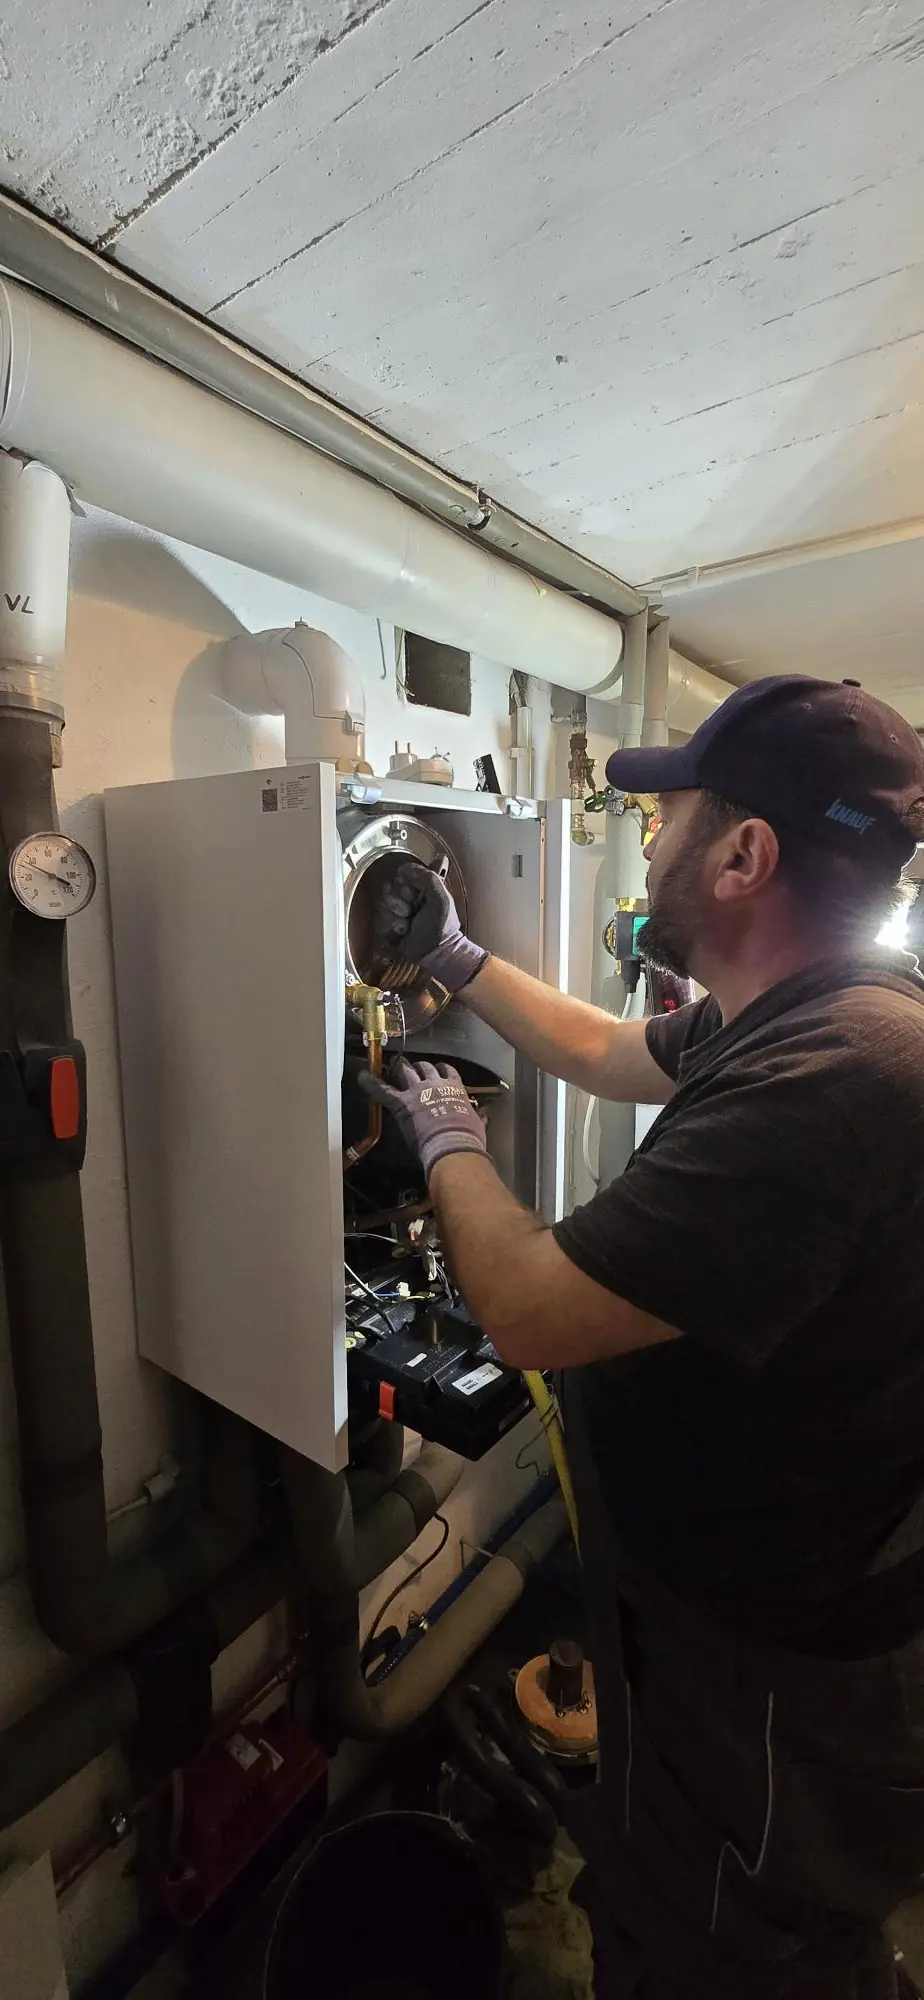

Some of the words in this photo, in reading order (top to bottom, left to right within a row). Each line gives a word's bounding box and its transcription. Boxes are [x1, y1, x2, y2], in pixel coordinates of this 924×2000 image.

[4, 593, 34, 614] VL
[825, 798, 876, 835] KNAUF
[44, 849, 52, 858] 60
[29, 857, 37, 865] 40
[60, 856, 68, 864] 80
[25, 873, 33, 881] 20
[33, 888, 38, 896] 0
[62, 886, 73, 894] 120
